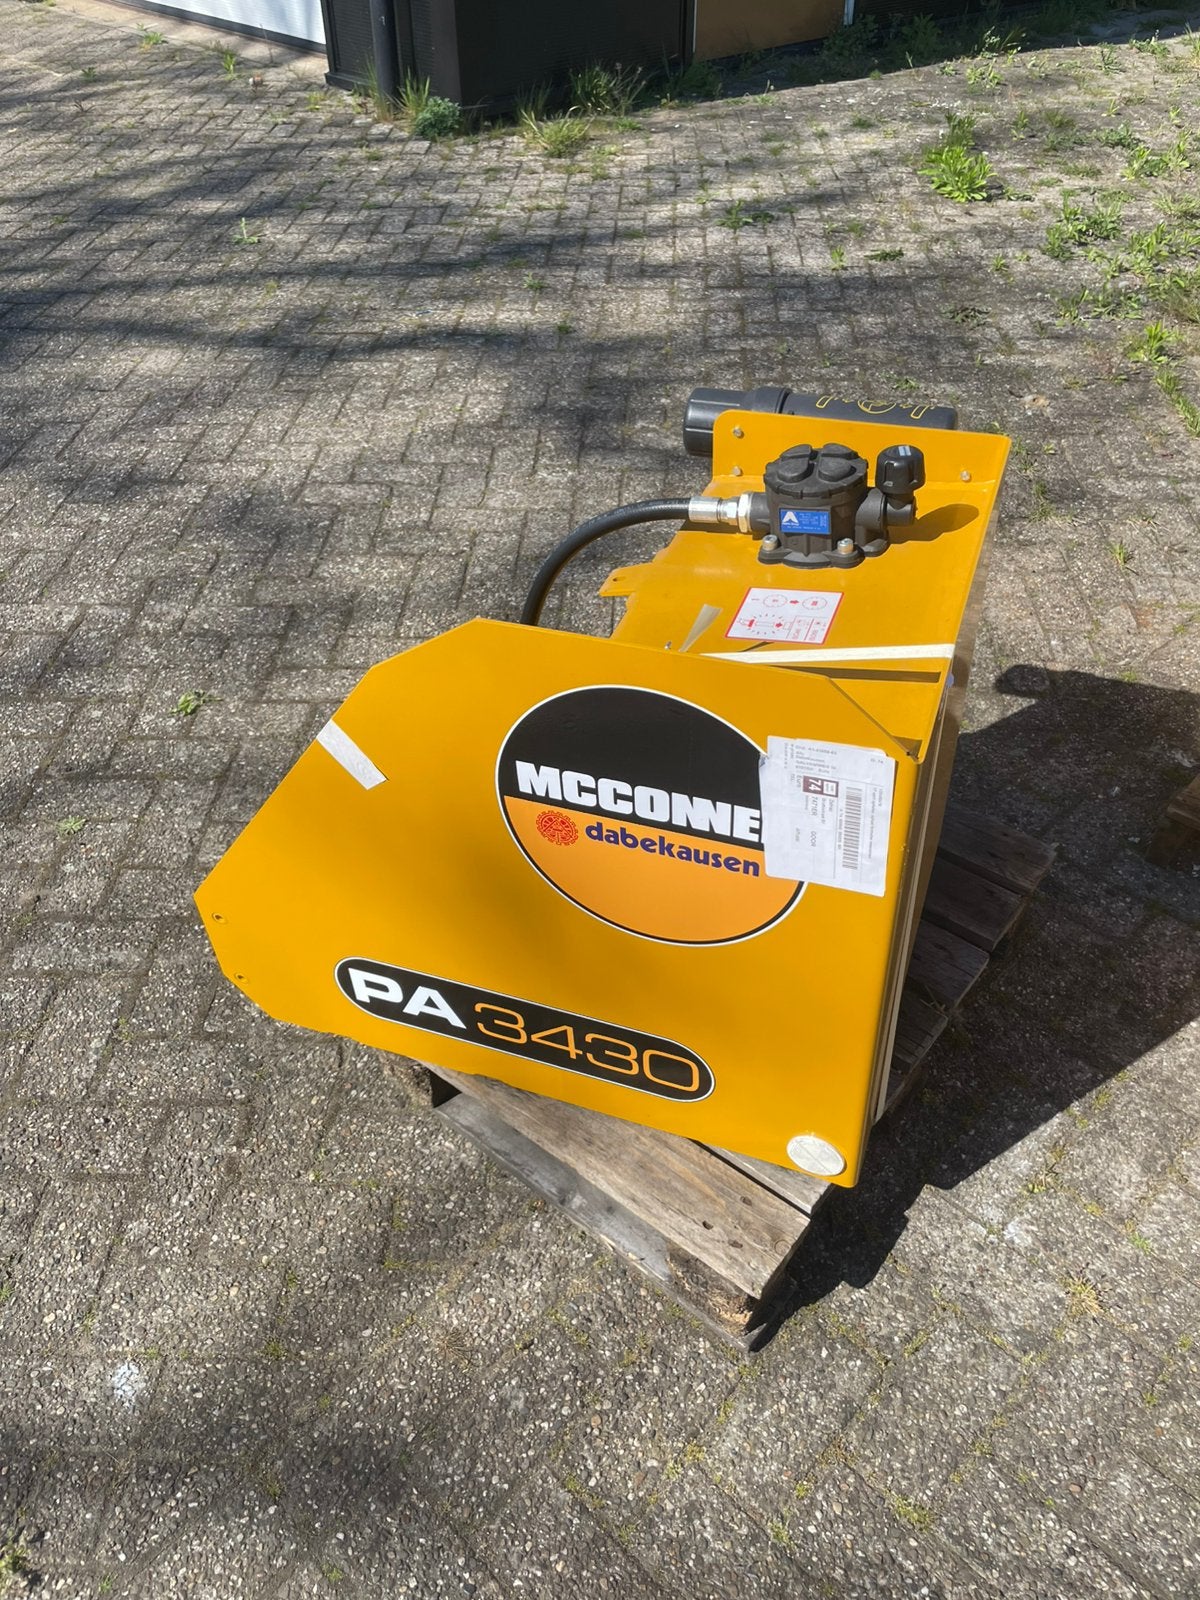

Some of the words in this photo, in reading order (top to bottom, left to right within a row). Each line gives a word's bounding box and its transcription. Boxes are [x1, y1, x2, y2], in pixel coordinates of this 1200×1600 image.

[515, 760, 765, 844] MCCONNE
[808, 778, 822, 792] 74
[585, 822, 760, 877] dabekausen
[348, 967, 467, 1029] PA
[474, 1003, 700, 1092] 3430
